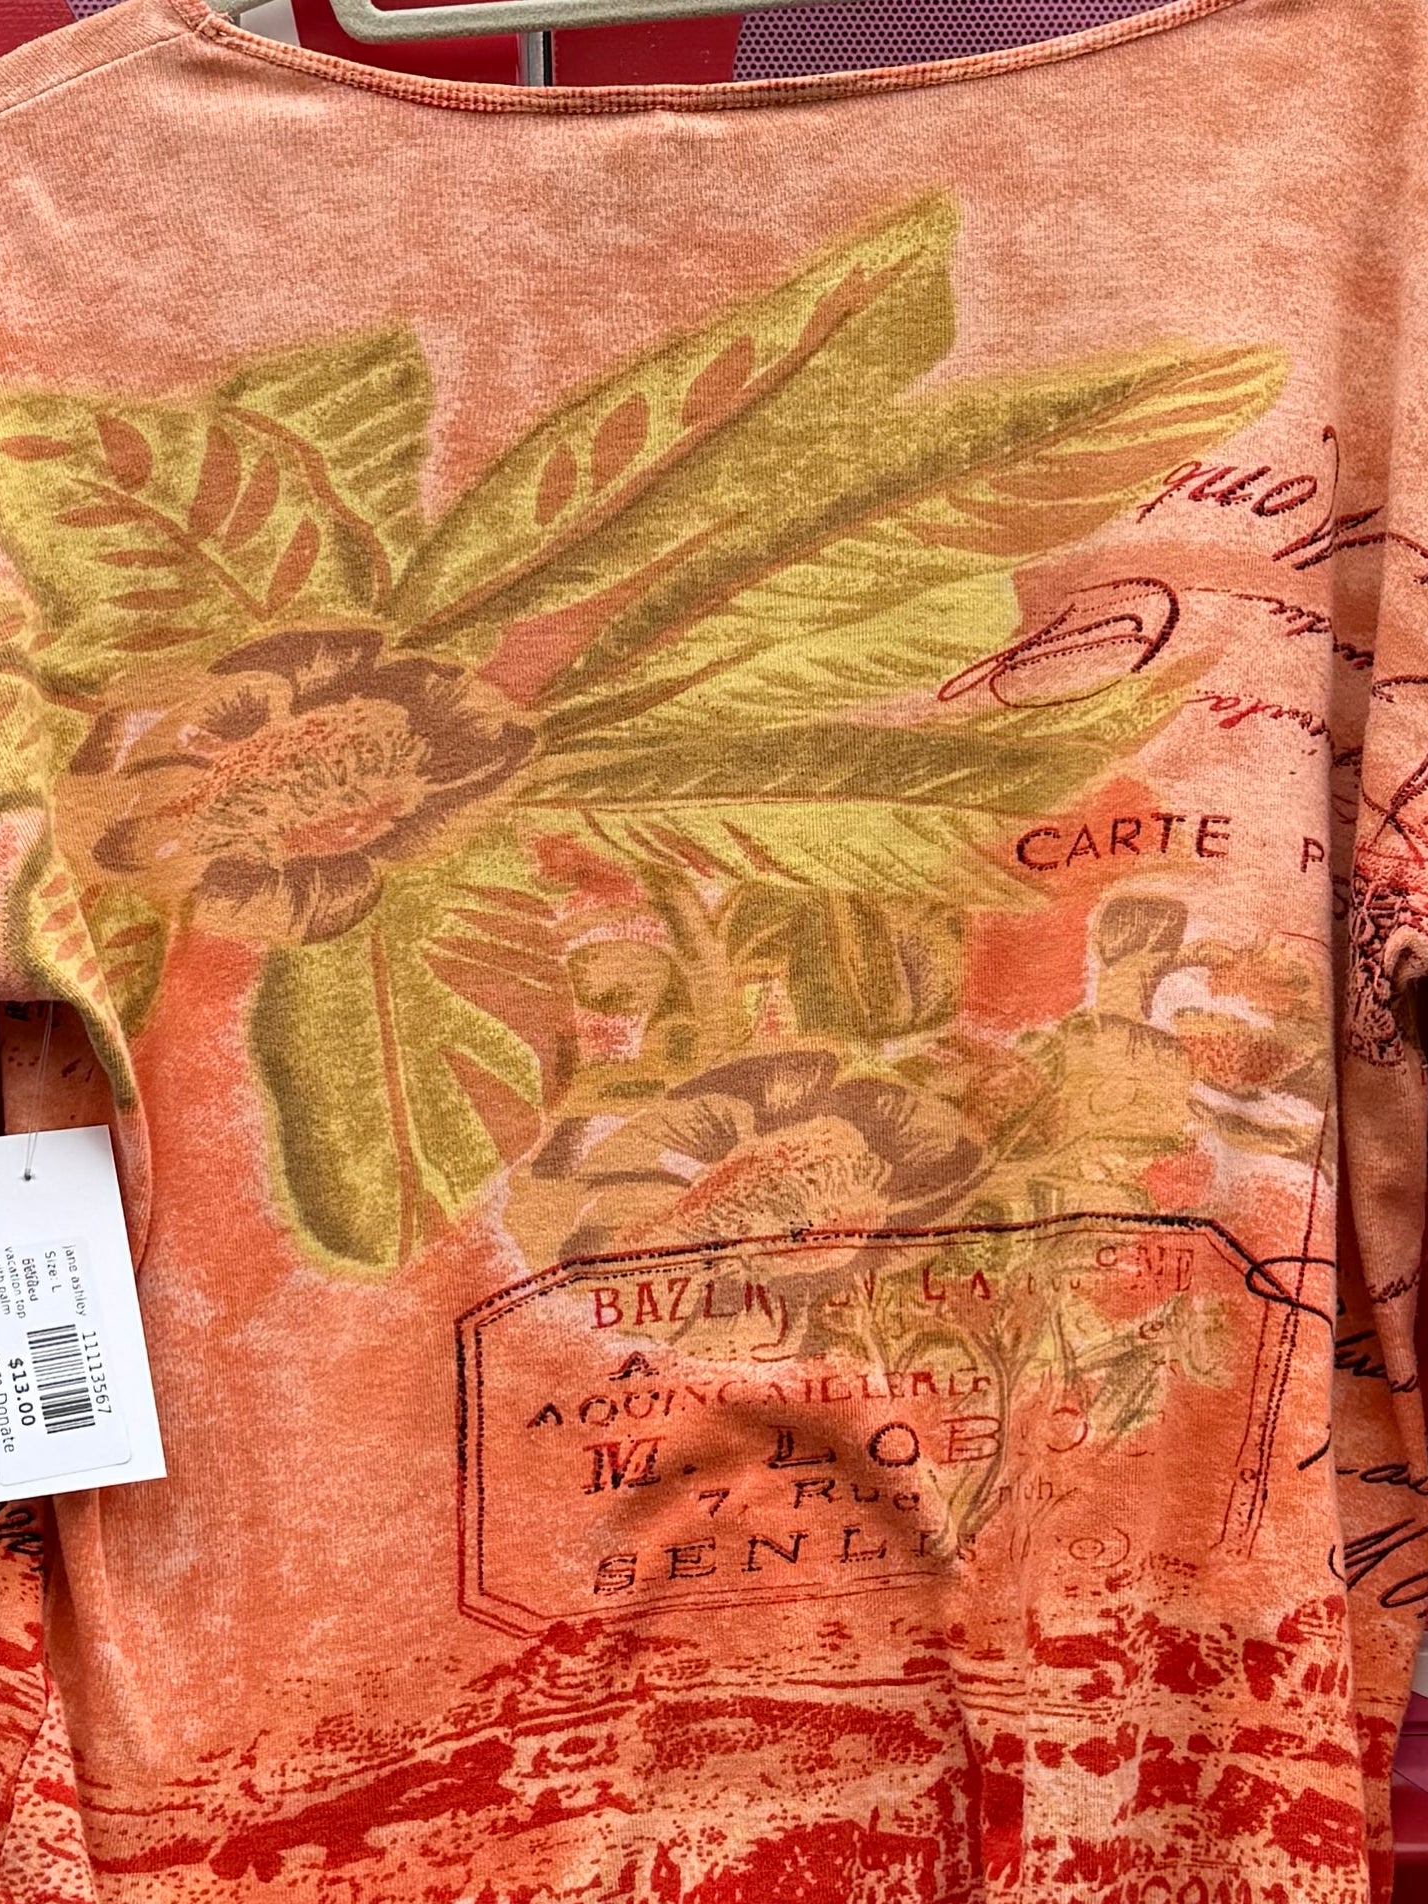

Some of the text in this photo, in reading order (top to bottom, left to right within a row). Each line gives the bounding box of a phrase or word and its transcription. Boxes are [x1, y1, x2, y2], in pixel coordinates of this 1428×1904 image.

[1014, 810, 1235, 872] CARTE
[4, 1246, 27, 1319] vacation top
[45, 1250, 62, 1294] Size: L
[62, 1244, 87, 1317] jane ashley
[7, 1357, 36, 1427] $13.00
[81, 1331, 112, 1414] 11113567
